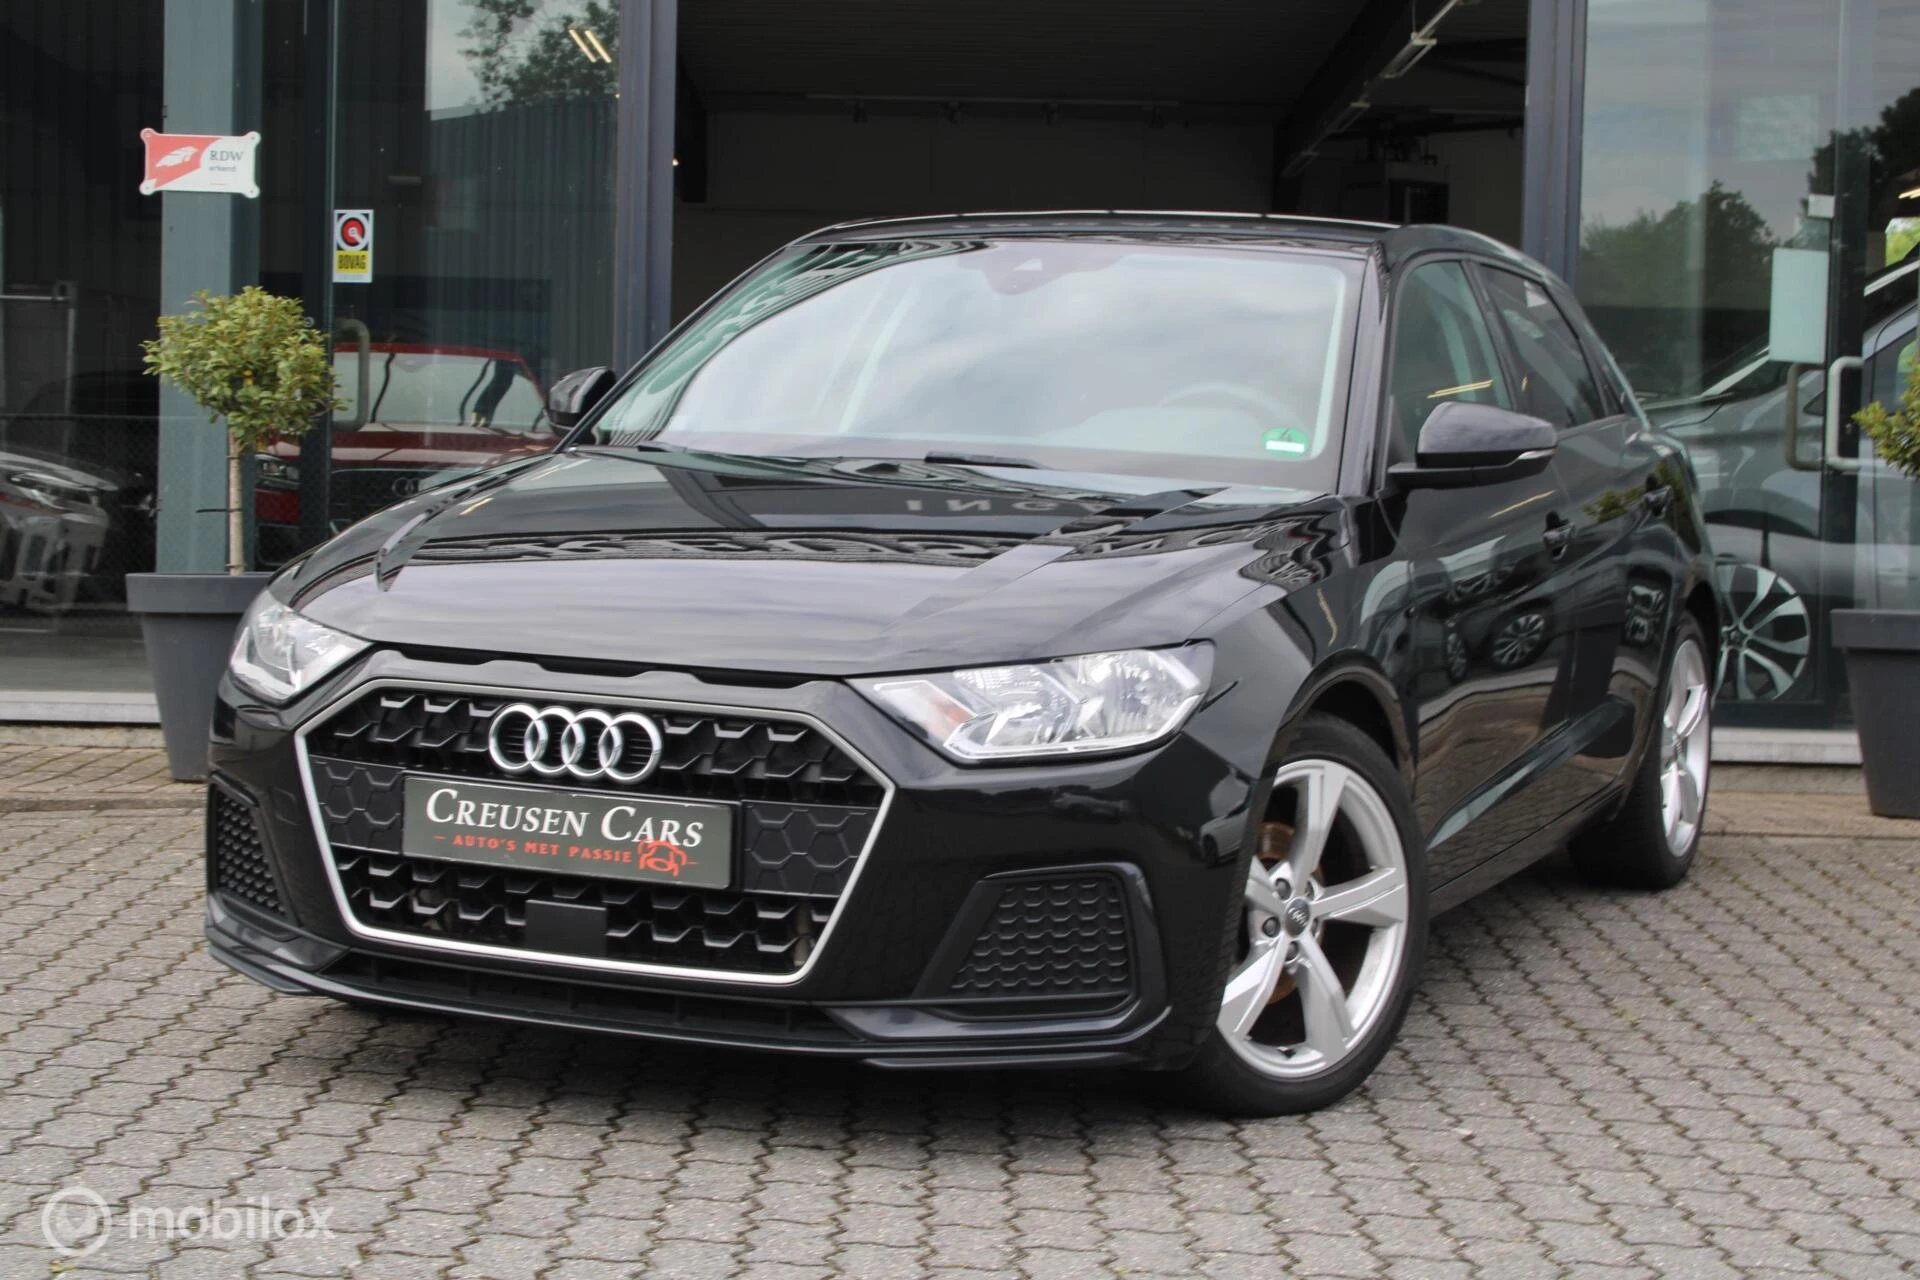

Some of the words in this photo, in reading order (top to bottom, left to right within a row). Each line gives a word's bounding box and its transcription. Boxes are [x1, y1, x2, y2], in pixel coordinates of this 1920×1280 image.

[209, 150, 245, 162] RDW
[338, 254, 367, 270] BOVAG
[426, 788, 591, 837] CREUSEN
[600, 806, 704, 847] CARS
[452, 834, 517, 852] AUTO'S
[524, 841, 559, 856] MET
[569, 846, 633, 863] PASSIE
